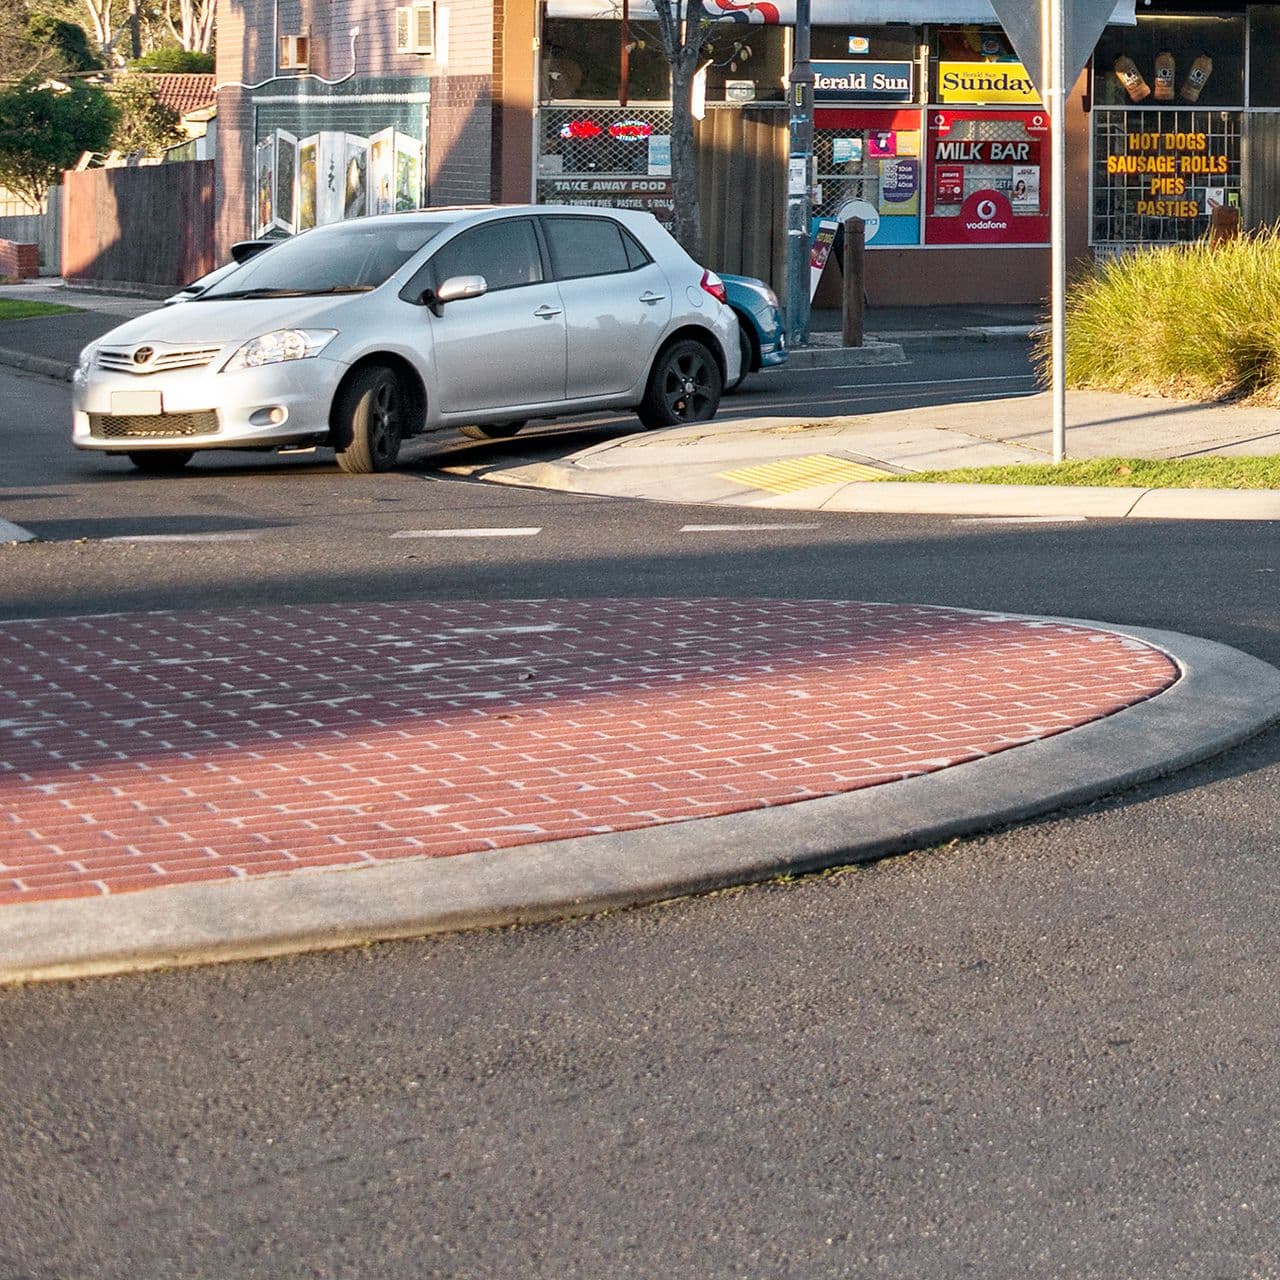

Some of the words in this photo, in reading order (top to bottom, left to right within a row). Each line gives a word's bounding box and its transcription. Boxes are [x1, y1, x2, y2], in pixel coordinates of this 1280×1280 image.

[872, 73, 909, 90] Sun
[943, 72, 1035, 95] Sunday
[1129, 132, 1161, 150] HOT
[1165, 132, 1206, 150] DOGS
[935, 142, 984, 161] MILK
[990, 142, 1030, 161] BAR
[1107, 155, 1176, 173] SAUSAGE
[1180, 155, 1228, 173] ROLLS
[555, 182, 588, 191] TAKE
[592, 181, 628, 191] AWAY
[632, 181, 667, 191] FOOD
[1150, 177, 1185, 195] PIES
[1137, 200, 1199, 217] PASTIES
[966, 221, 1008, 230] vodafone
